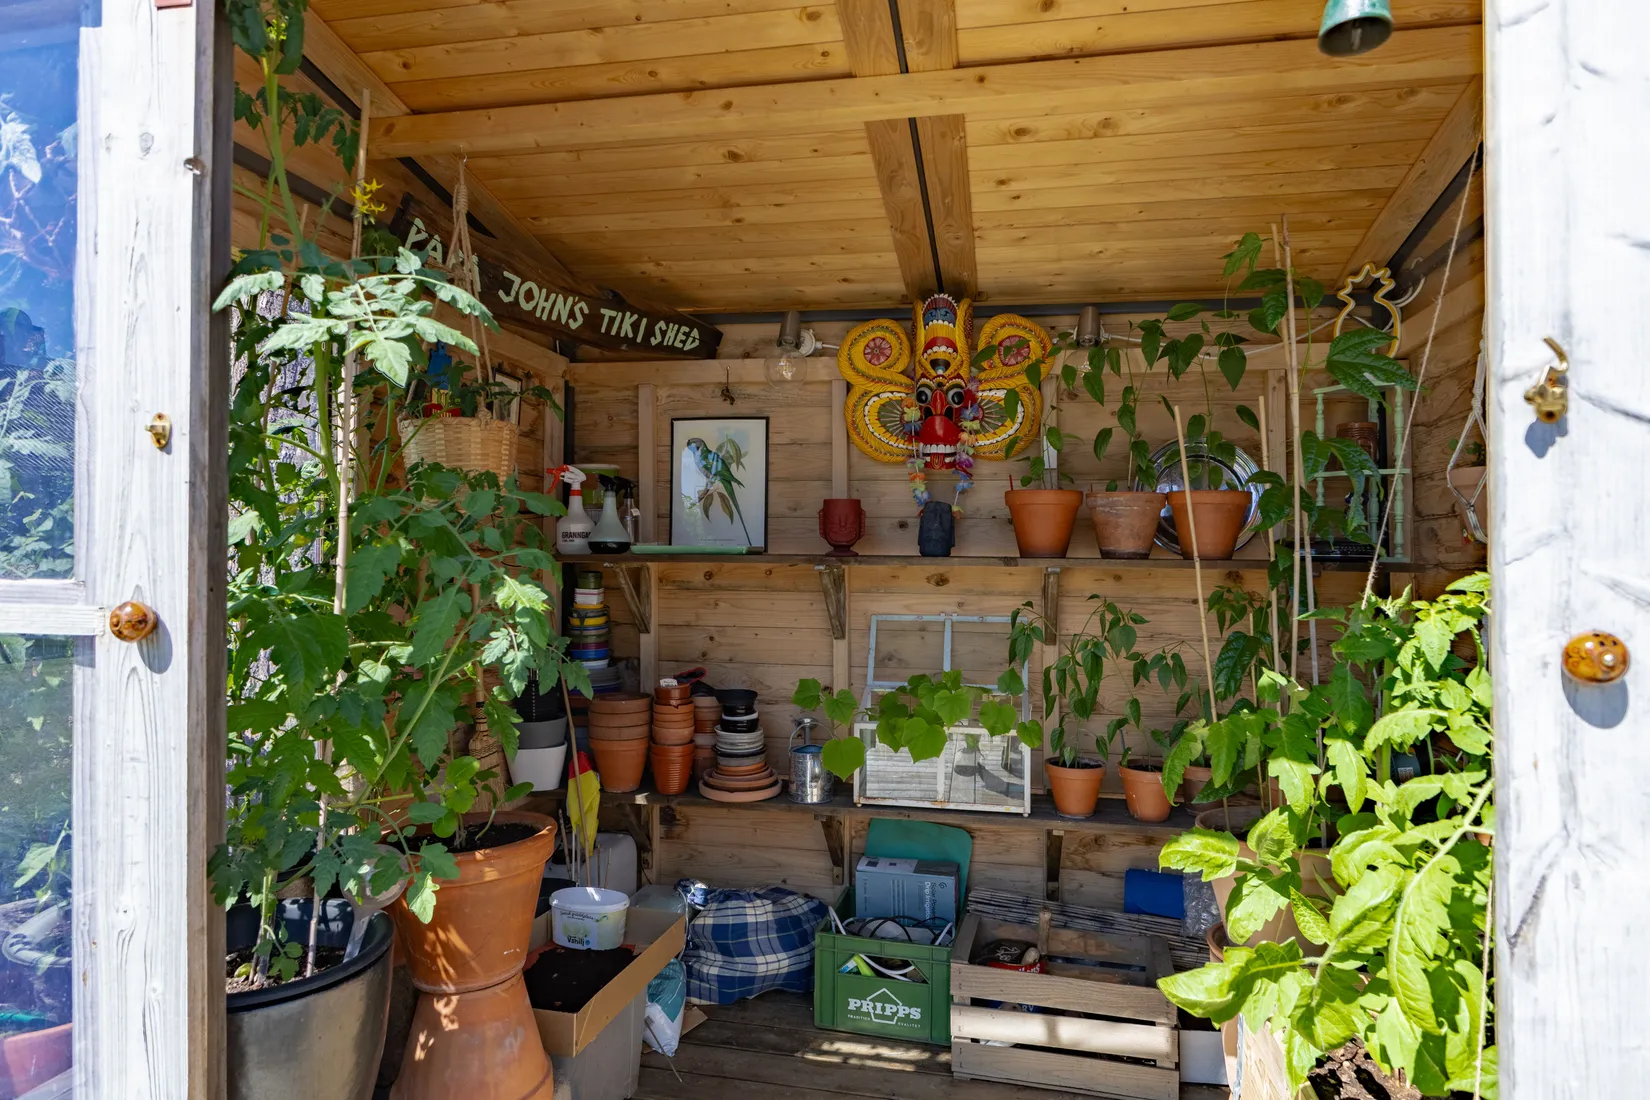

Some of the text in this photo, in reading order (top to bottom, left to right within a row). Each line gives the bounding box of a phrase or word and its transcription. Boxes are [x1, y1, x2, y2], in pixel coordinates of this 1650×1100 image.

[498, 270, 589, 330] JOHN'S
[600, 307, 648, 343] TIKI
[649, 320, 700, 351] SHED
[567, 935, 585, 946] Vanilj
[847, 998, 921, 1020] PRIPPS
